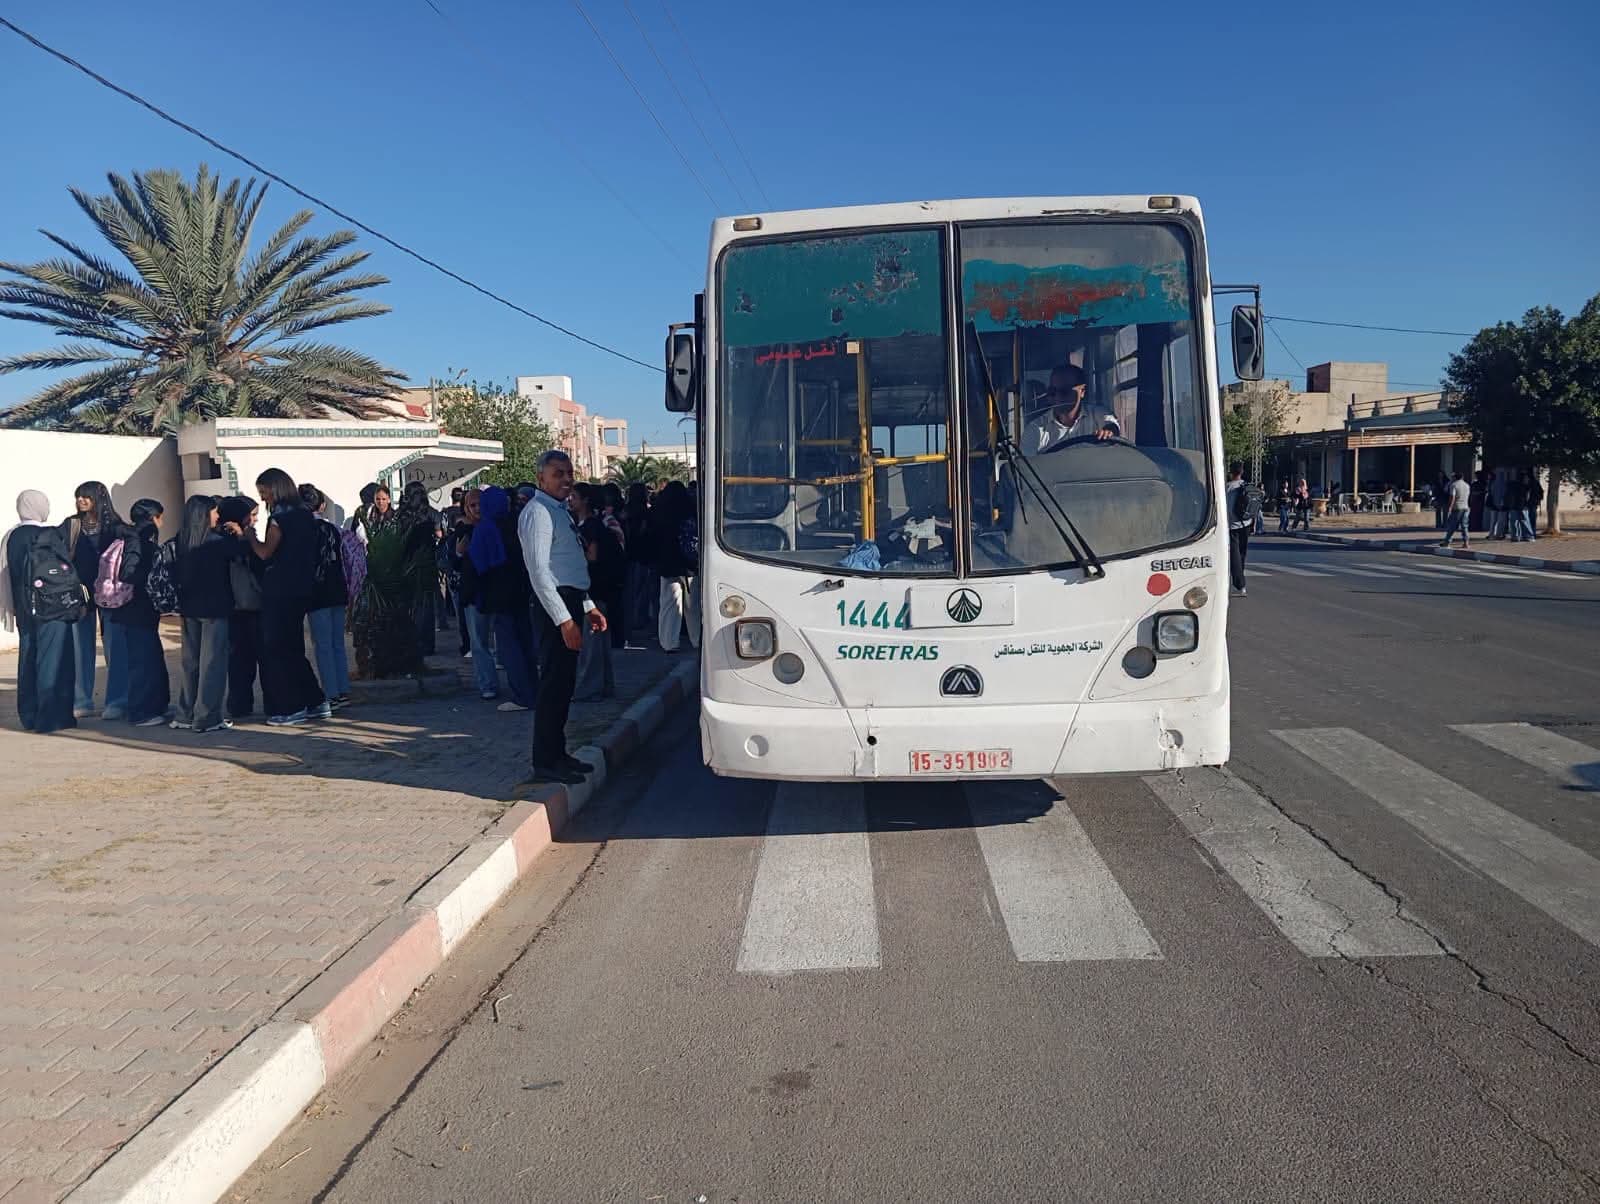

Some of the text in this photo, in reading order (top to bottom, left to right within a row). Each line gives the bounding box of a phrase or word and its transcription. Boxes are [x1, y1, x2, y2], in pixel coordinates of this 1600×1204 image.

[1151, 556, 1213, 572] SETCAR
[836, 645, 939, 661] SORETRAS
[994, 640, 1103, 659] الشركة الجهوية للنقل بصفاقس
